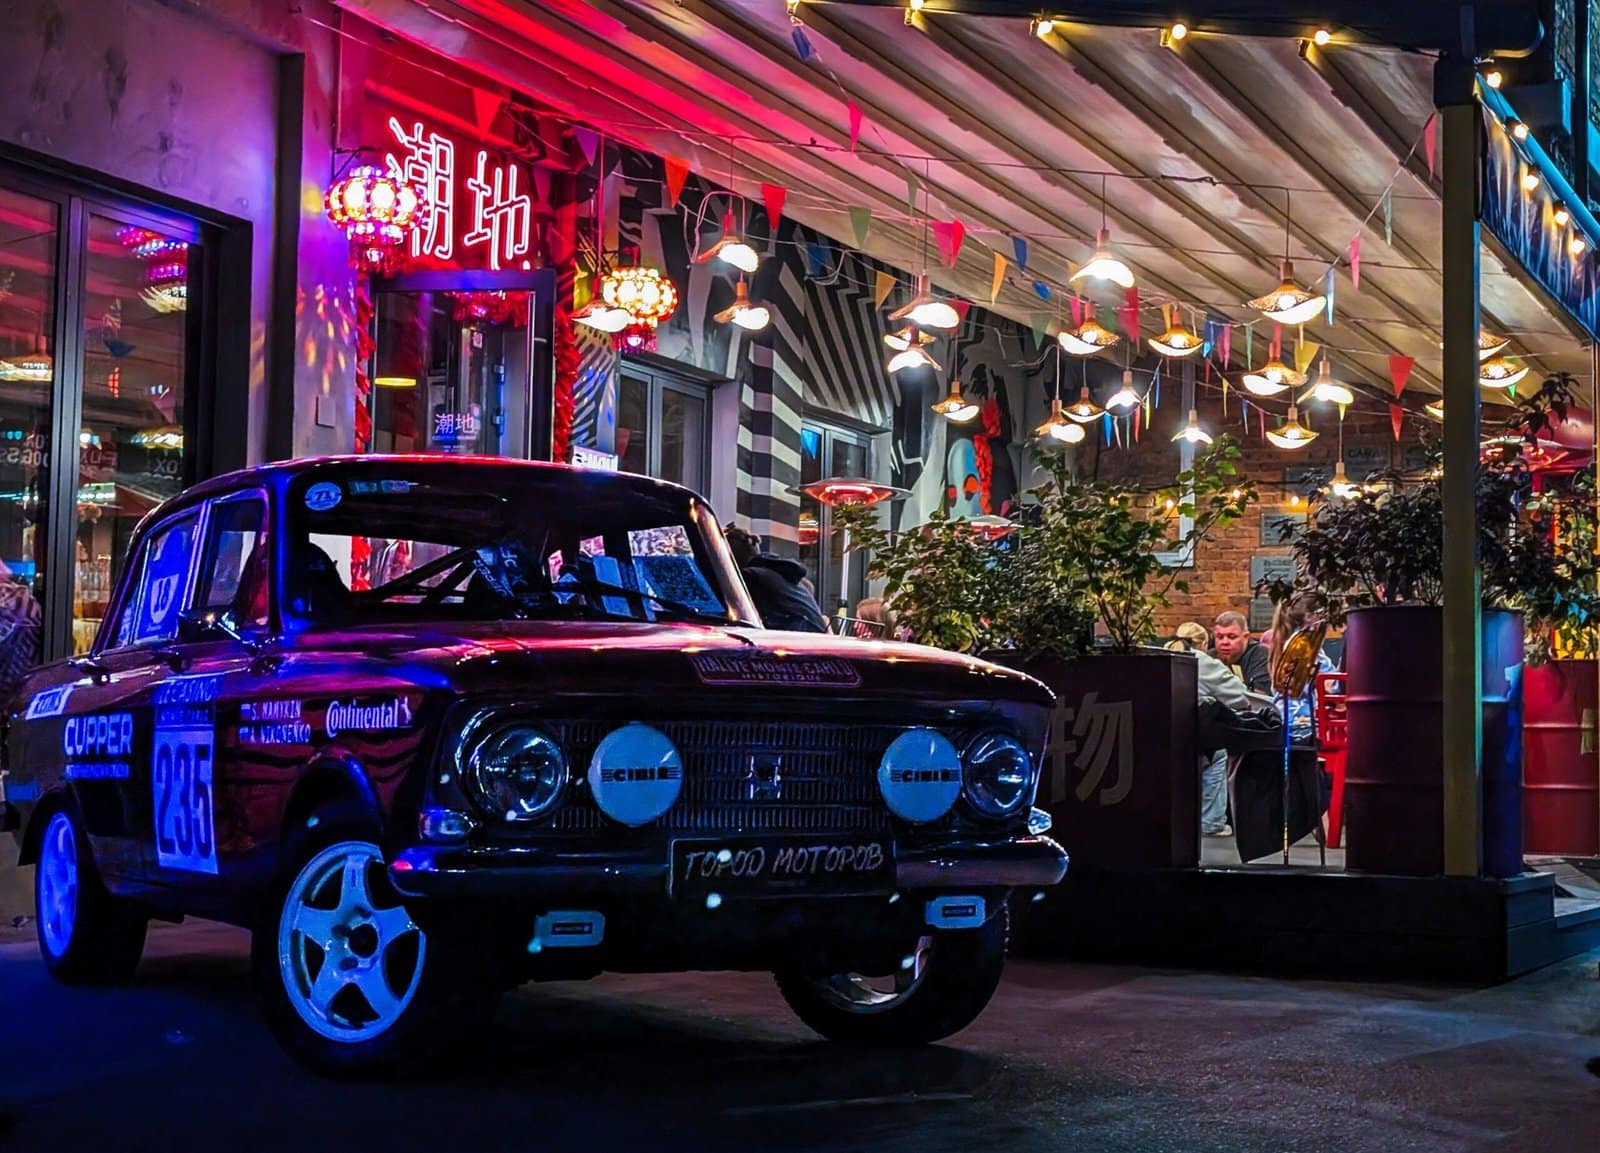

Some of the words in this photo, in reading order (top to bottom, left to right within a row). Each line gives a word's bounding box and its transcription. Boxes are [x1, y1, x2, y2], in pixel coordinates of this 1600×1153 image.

[384, 116, 532, 271] 潮地
[64, 712, 133, 757] CUPPER
[326, 698, 399, 738] Continental
[1047, 691, 1133, 805] 物
[155, 743, 212, 859] 235
